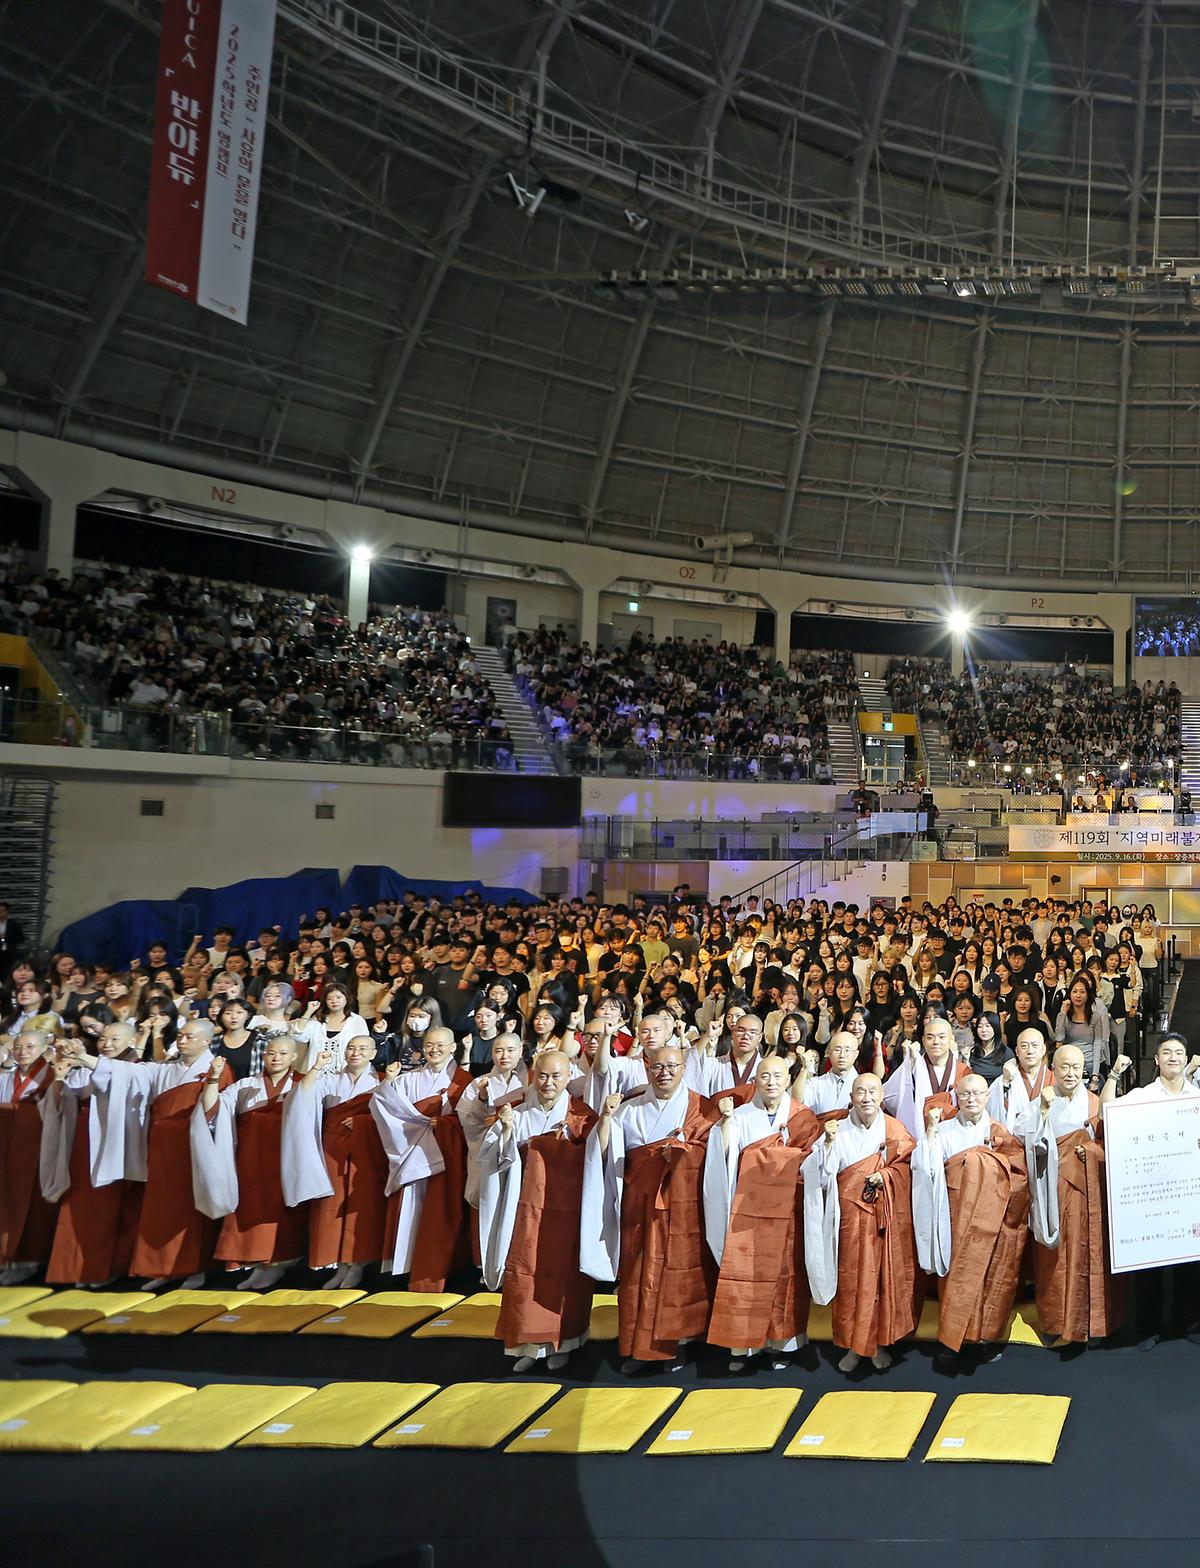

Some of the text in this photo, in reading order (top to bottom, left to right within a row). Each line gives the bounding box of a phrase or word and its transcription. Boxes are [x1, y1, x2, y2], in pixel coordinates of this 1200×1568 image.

[217, 23, 240, 129] 2025학년도
[212, 486, 236, 504] N2
[1031, 597, 1045, 609] P2
[1059, 830, 1110, 846] 제119회
